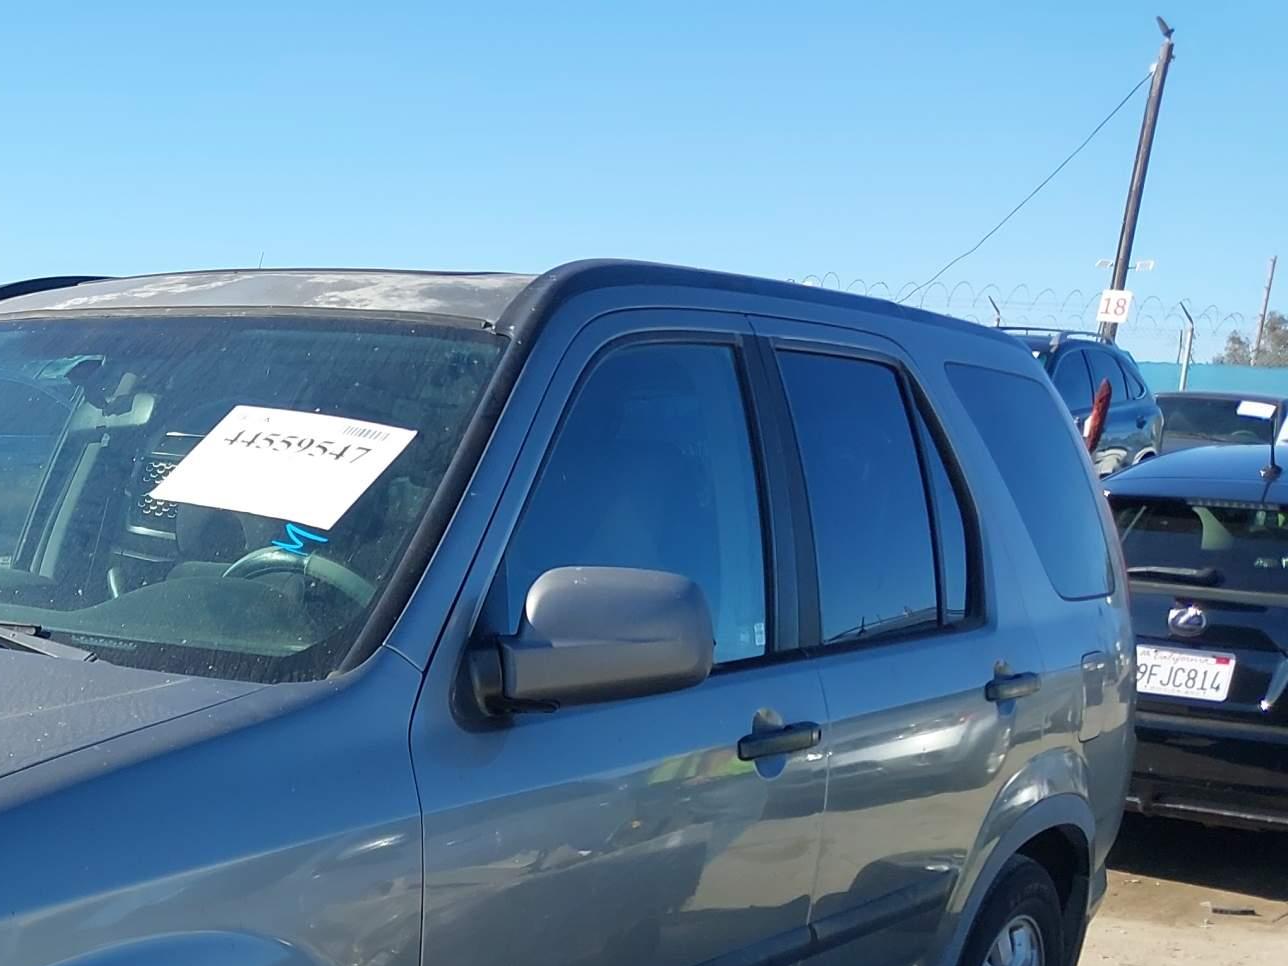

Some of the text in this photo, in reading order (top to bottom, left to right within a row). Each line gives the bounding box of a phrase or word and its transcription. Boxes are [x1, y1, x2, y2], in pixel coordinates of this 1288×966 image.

[1100, 296, 1127, 316] 18
[223, 429, 373, 464] 44559547
[1136, 664, 1221, 692] 9FJC814
